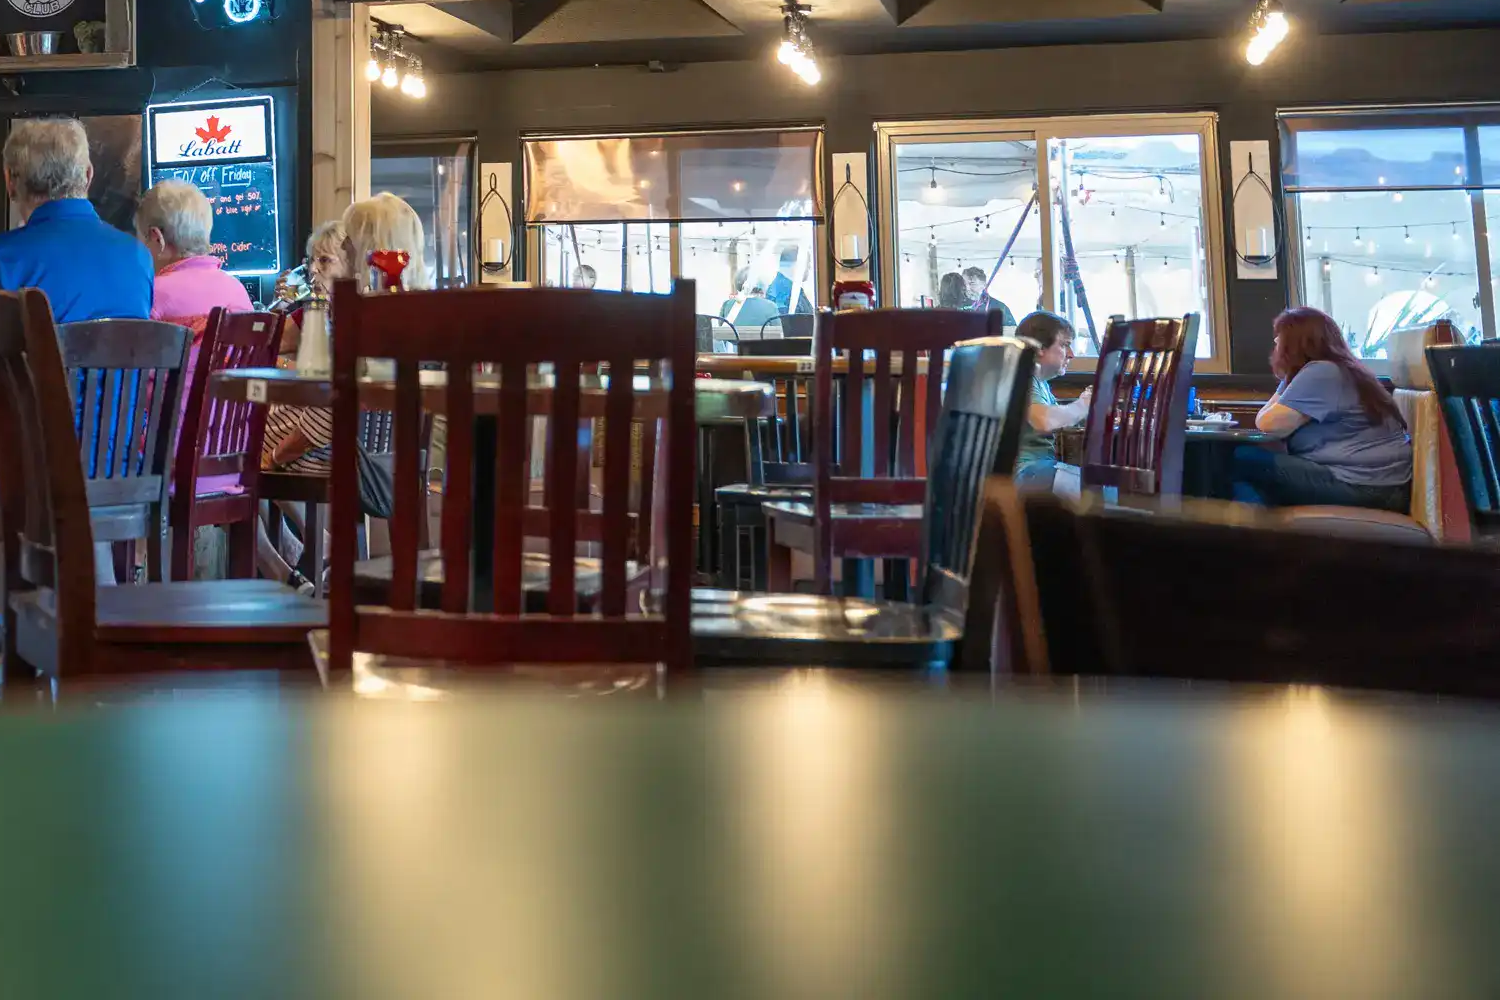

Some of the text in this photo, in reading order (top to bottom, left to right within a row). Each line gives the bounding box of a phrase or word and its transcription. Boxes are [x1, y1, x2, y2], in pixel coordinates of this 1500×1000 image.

[23, 0, 60, 15] CLUB
[177, 138, 242, 158] Labatt
[200, 166, 218, 183] off
[231, 241, 252, 252] Cider
